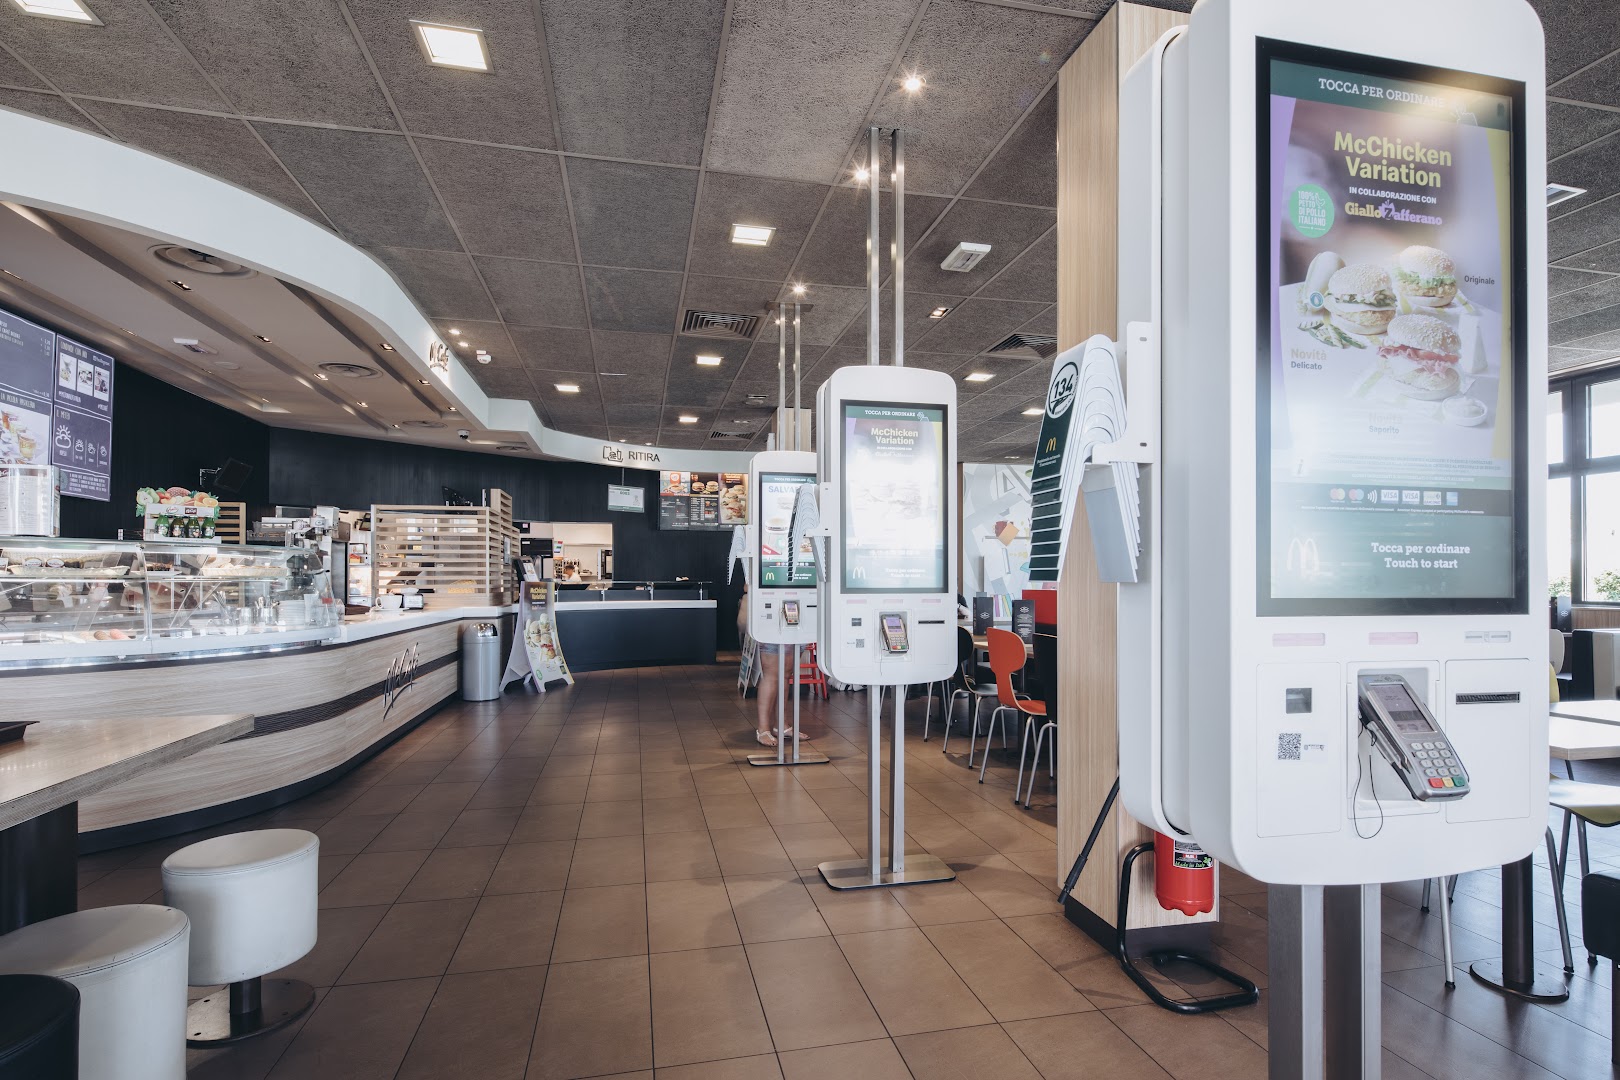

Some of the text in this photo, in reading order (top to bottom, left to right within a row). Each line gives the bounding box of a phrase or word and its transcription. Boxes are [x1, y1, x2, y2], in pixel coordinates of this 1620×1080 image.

[1318, 78, 1446, 108] TOCCA PER ORDINARE
[1334, 130, 1452, 167] McChicken
[1345, 155, 1441, 188] Variation
[1297, 190, 1315, 201] 100%
[1349, 186, 1437, 204] IN COLLABORAZIONE CON
[1298, 199, 1316, 208] PETTO
[1298, 206, 1326, 217] DI POLLO
[1298, 215, 1326, 227] ITALIANO
[1464, 275, 1495, 286] Originale
[1290, 347, 1327, 361] Novità
[1290, 360, 1323, 370] Delicato
[1053, 373, 1075, 399] 134
[871, 427, 919, 437] McChicken
[1368, 425, 1400, 435] Saporito
[875, 435, 914, 445] Variation
[628, 450, 660, 462] RITIRA
[1383, 491, 1419, 500] VISA VISA
[1370, 542, 1470, 555] Tocca per ordinare
[1384, 557, 1458, 569] Touch to start
